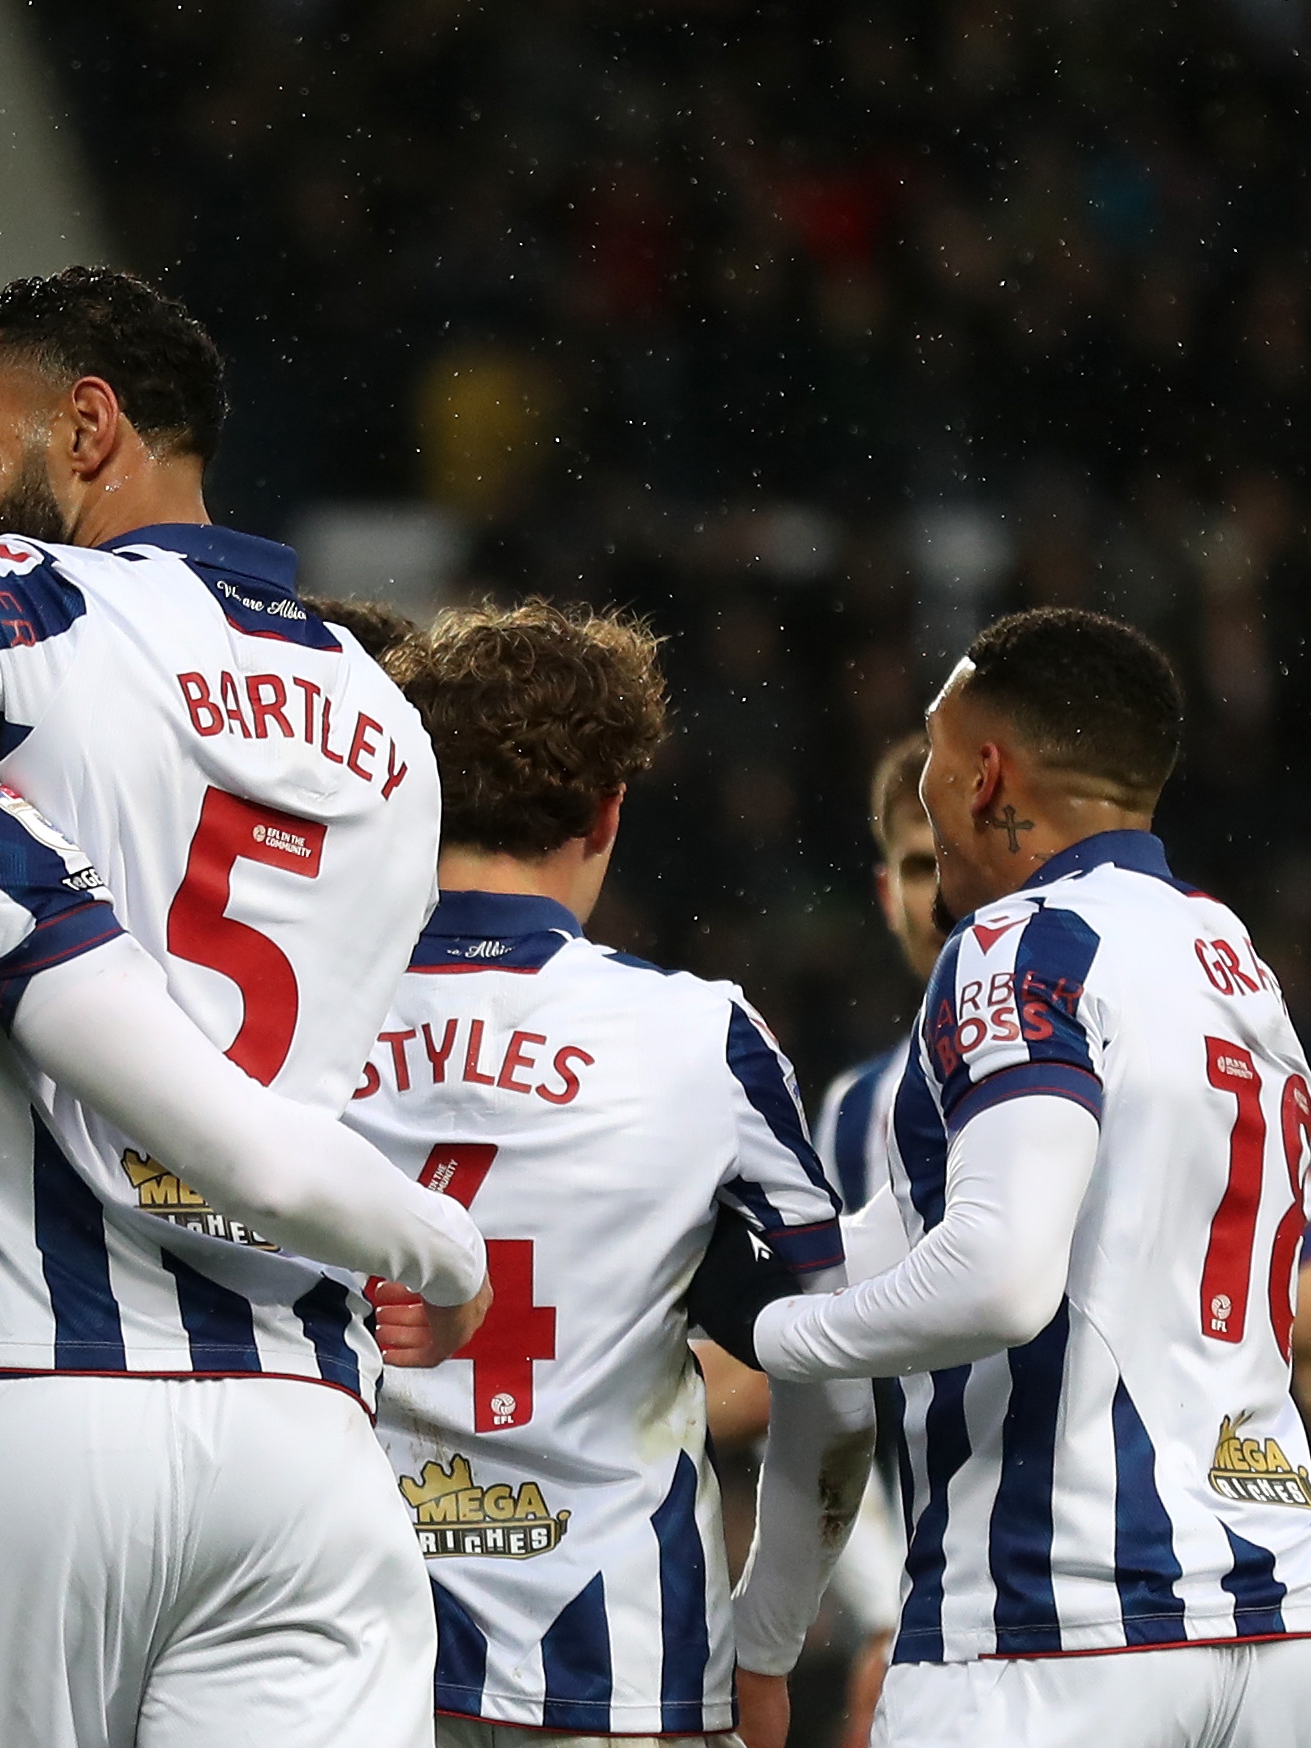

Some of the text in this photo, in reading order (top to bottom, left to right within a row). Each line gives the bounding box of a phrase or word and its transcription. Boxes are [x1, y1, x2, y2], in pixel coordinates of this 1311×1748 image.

[267, 599, 307, 621] Albio
[177, 670, 408, 801] BARTLEY
[265, 837, 312, 858] COMMUNITY
[267, 827, 282, 841] EFL
[292, 832, 306, 847] THE
[165, 784, 328, 1087] 5
[926, 971, 1085, 1041] ARBER
[937, 1002, 1054, 1077] BOSS
[141, 1175, 205, 1205] ME
[364, 1143, 557, 1434] 4
[1210, 1318, 1228, 1333] EFL
[493, 1415, 514, 1426] EFL
[1215, 1438, 1292, 1472] MEGA
[418, 1484, 548, 1523] MEGA
[1216, 1477, 1307, 1505] RICHES
[419, 1528, 549, 1555] RICHES
